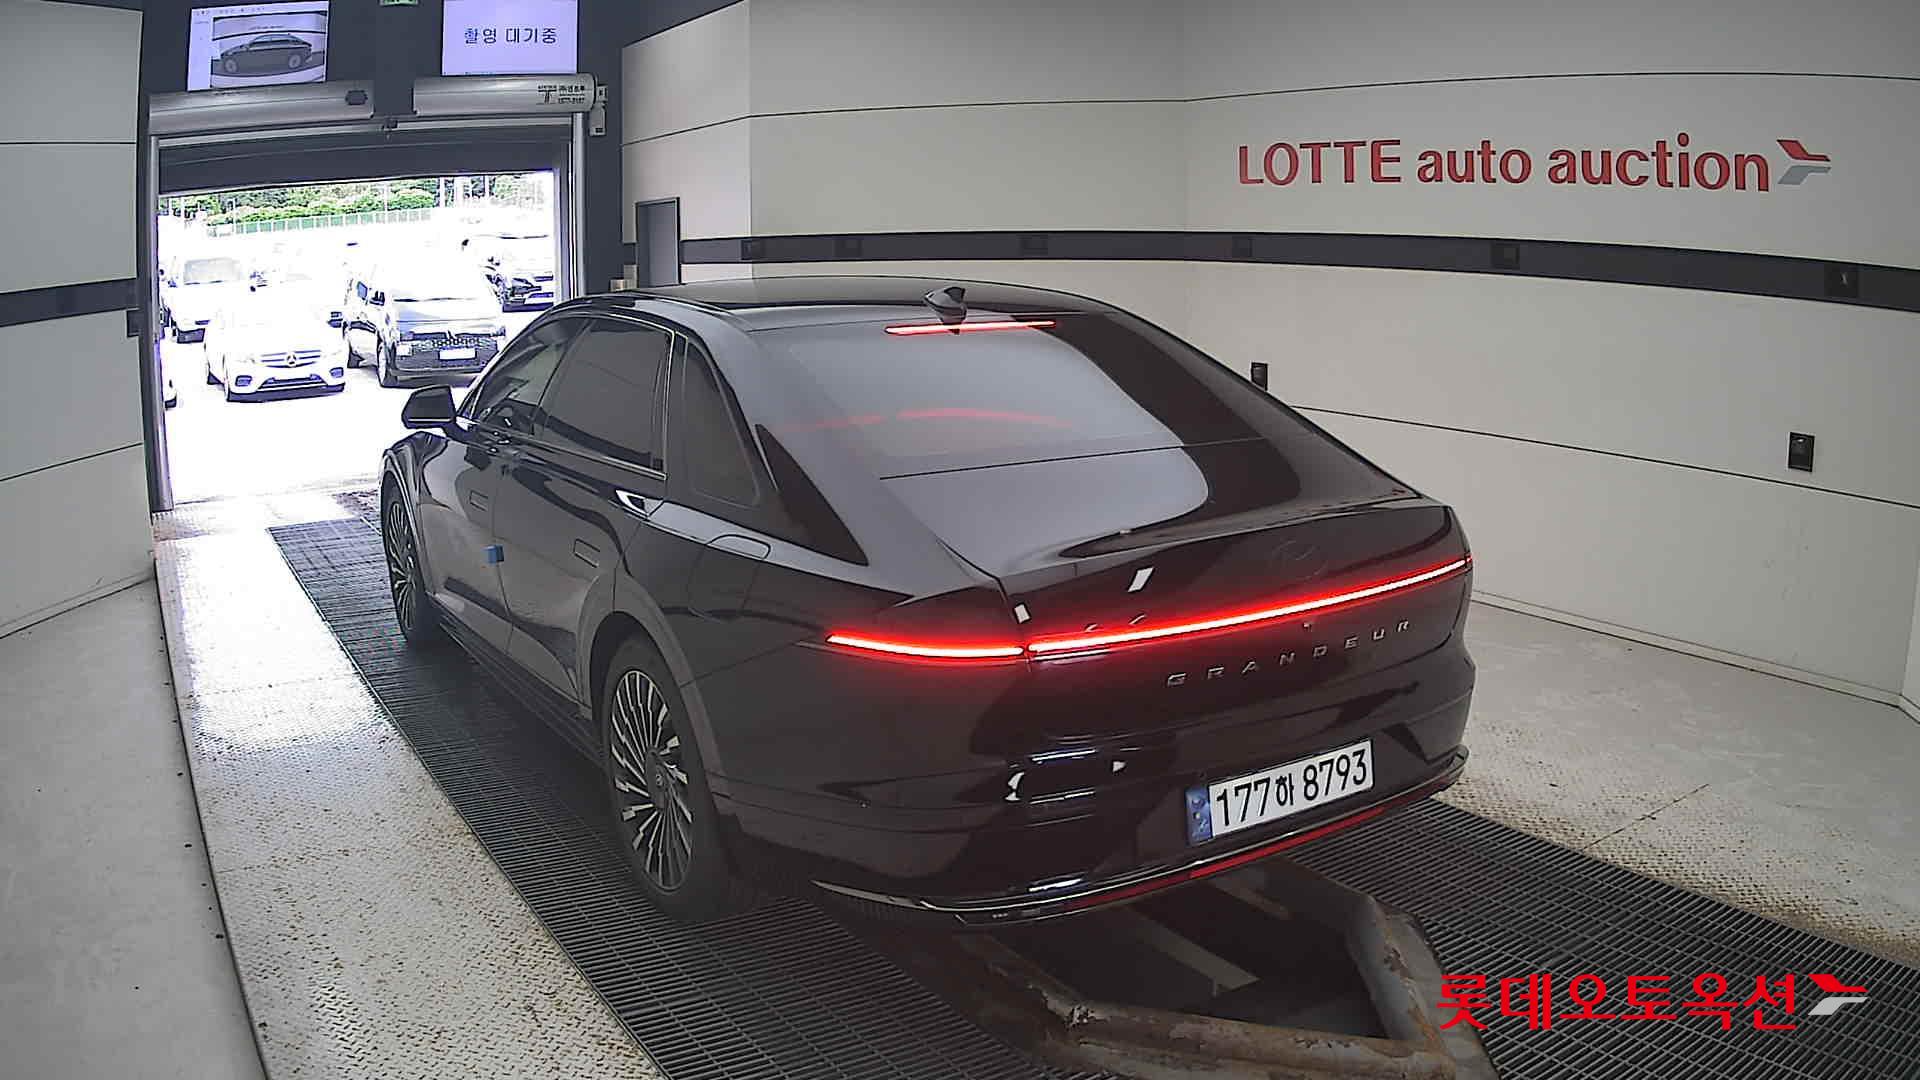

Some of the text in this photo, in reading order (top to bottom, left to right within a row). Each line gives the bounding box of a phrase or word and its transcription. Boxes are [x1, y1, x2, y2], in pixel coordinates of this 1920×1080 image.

[505, 27, 557, 44] 대기중
[1238, 132, 1769, 192] LOTTE auto auction
[1167, 620, 1409, 687] GRANDEUR
[1216, 748, 1367, 827] 177하 8793
